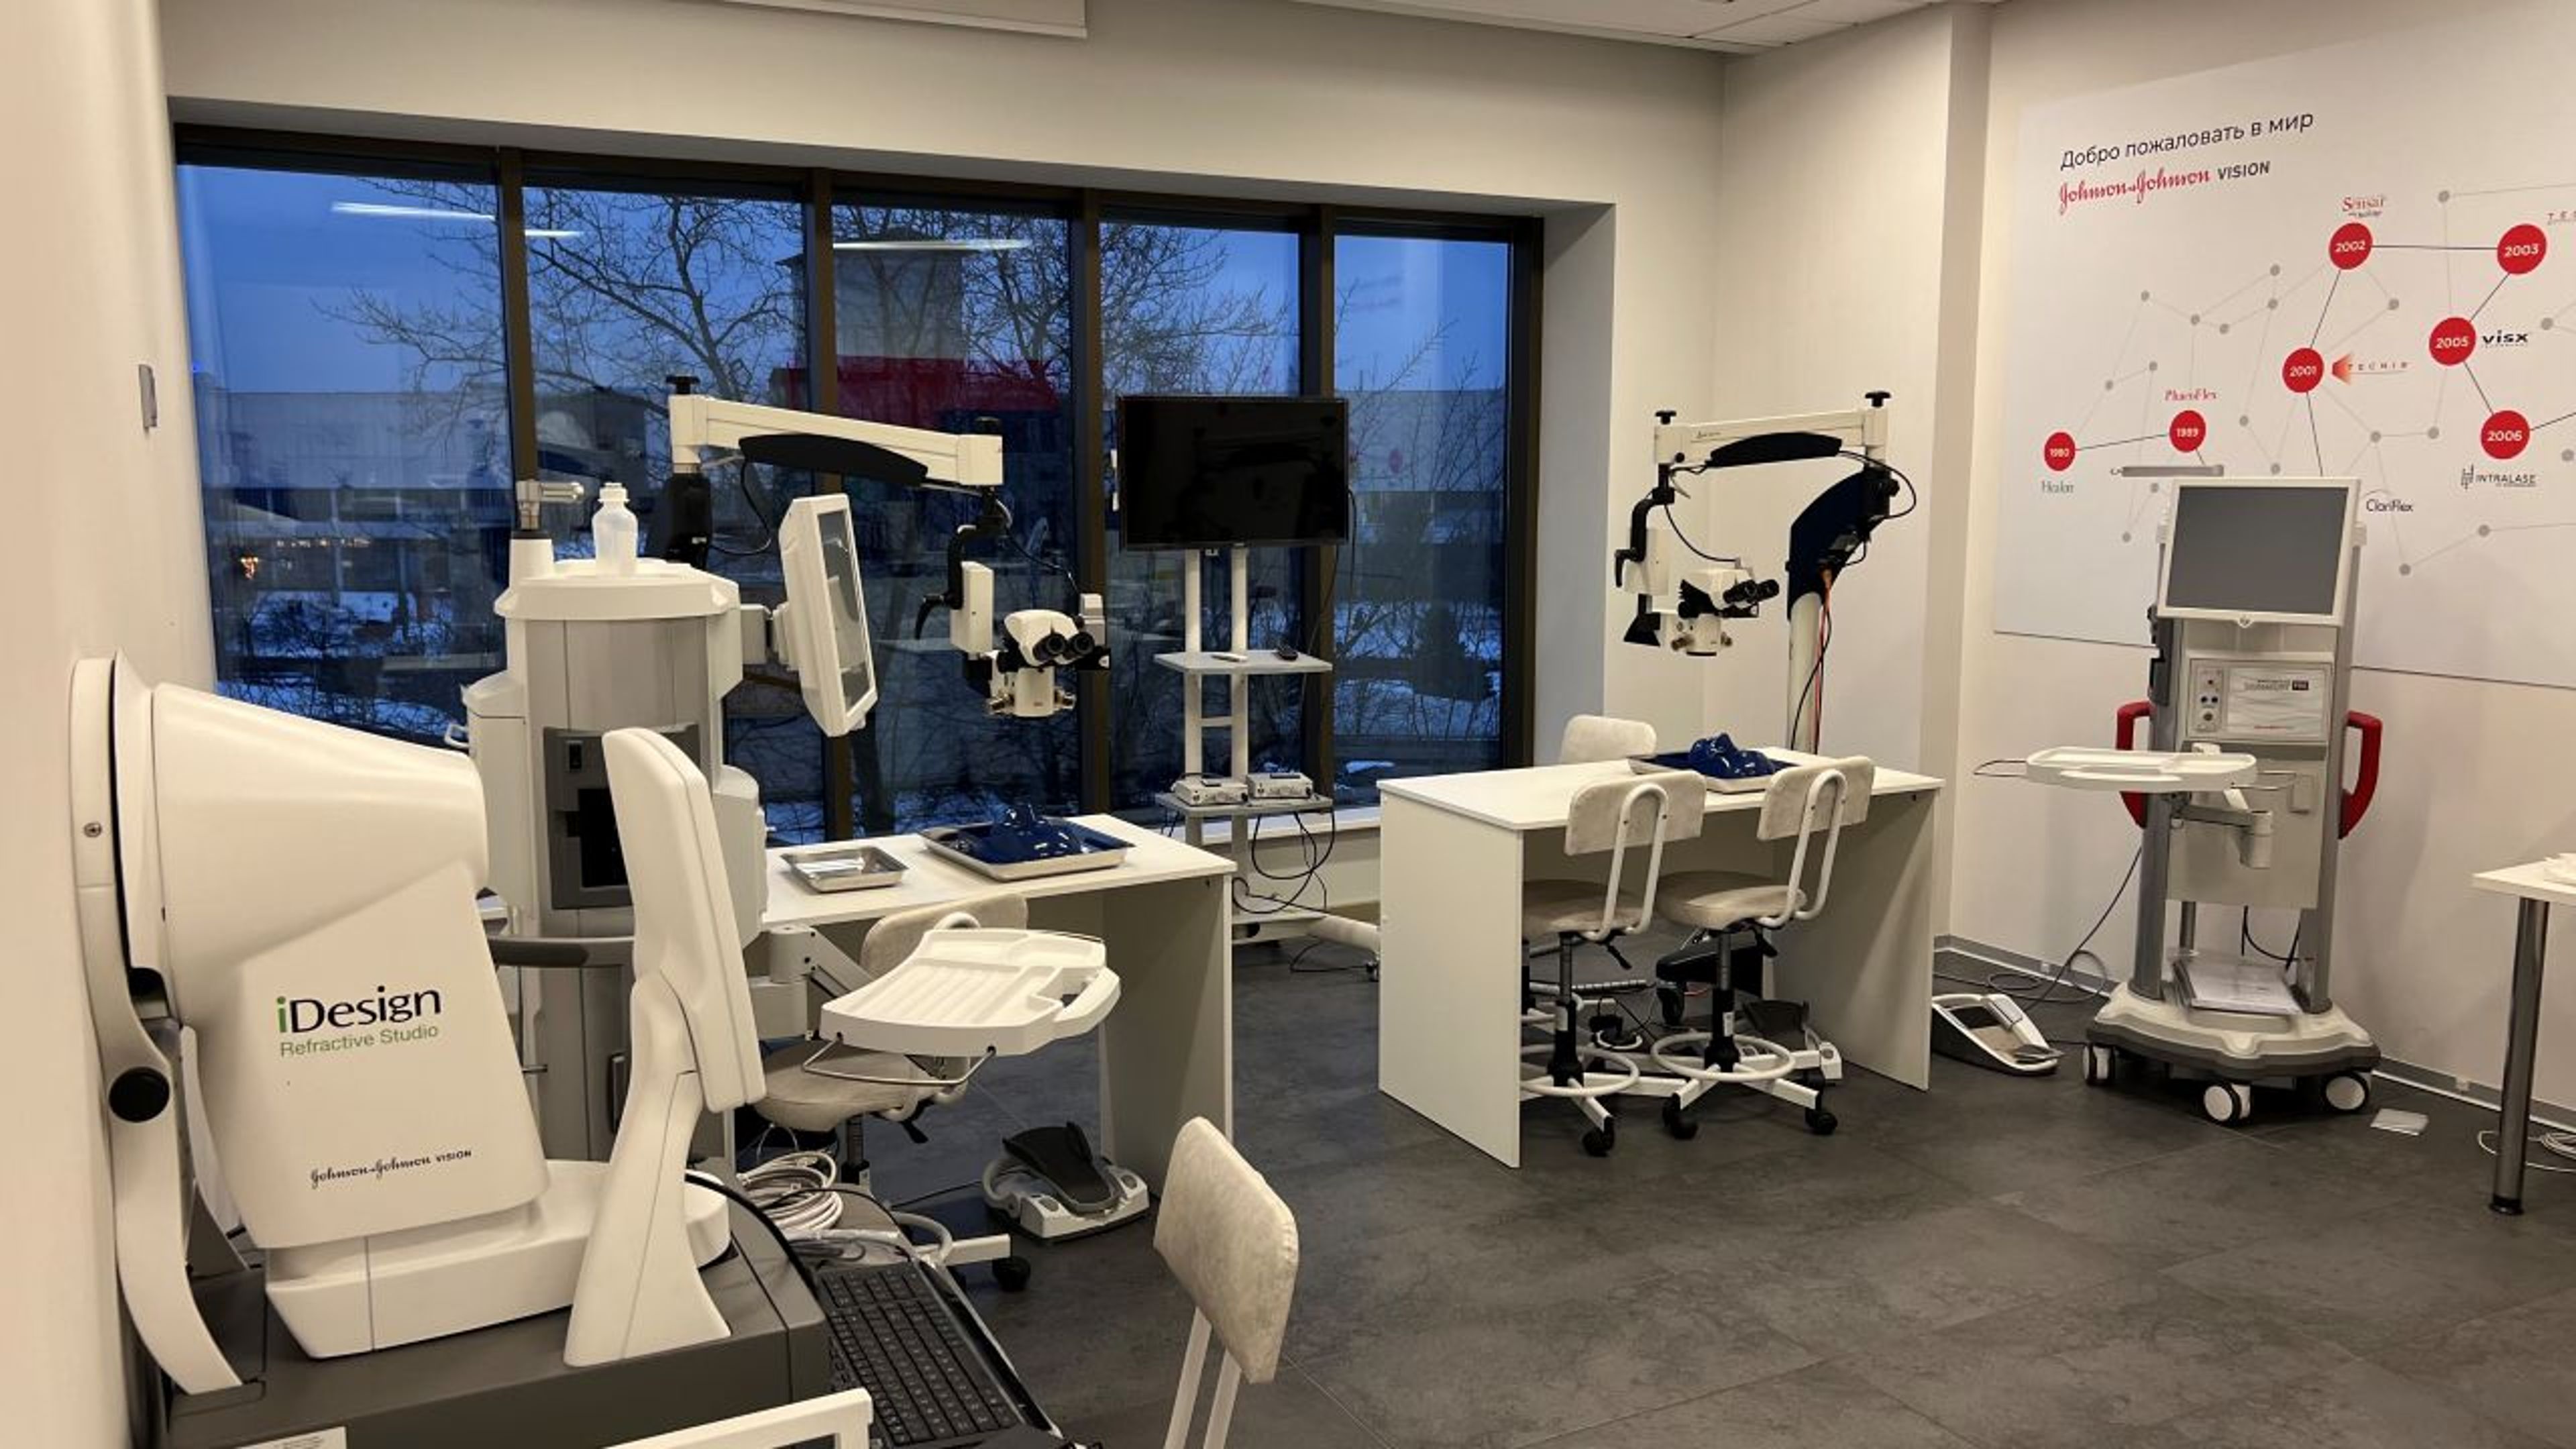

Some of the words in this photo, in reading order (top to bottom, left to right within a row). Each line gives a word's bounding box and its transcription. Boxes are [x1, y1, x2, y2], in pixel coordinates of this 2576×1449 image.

[2059, 145, 2120, 171] Добро
[2125, 124, 2245, 158] пожаловать
[2251, 121, 2261, 137] в
[2268, 113, 2314, 133] мир
[2217, 161, 2271, 181] VISION
[2334, 240, 2366, 253] 2002
[2504, 243, 2539, 257] 2003
[2434, 336, 2469, 349] 2005
[2290, 366, 2317, 377] 2001
[2487, 430, 2522, 442] 2006
[276, 985, 442, 1034] iDesign
[280, 1033, 375, 1057] Refractive
[379, 1024, 439, 1044] Studio
[435, 1149, 472, 1163] VISION
